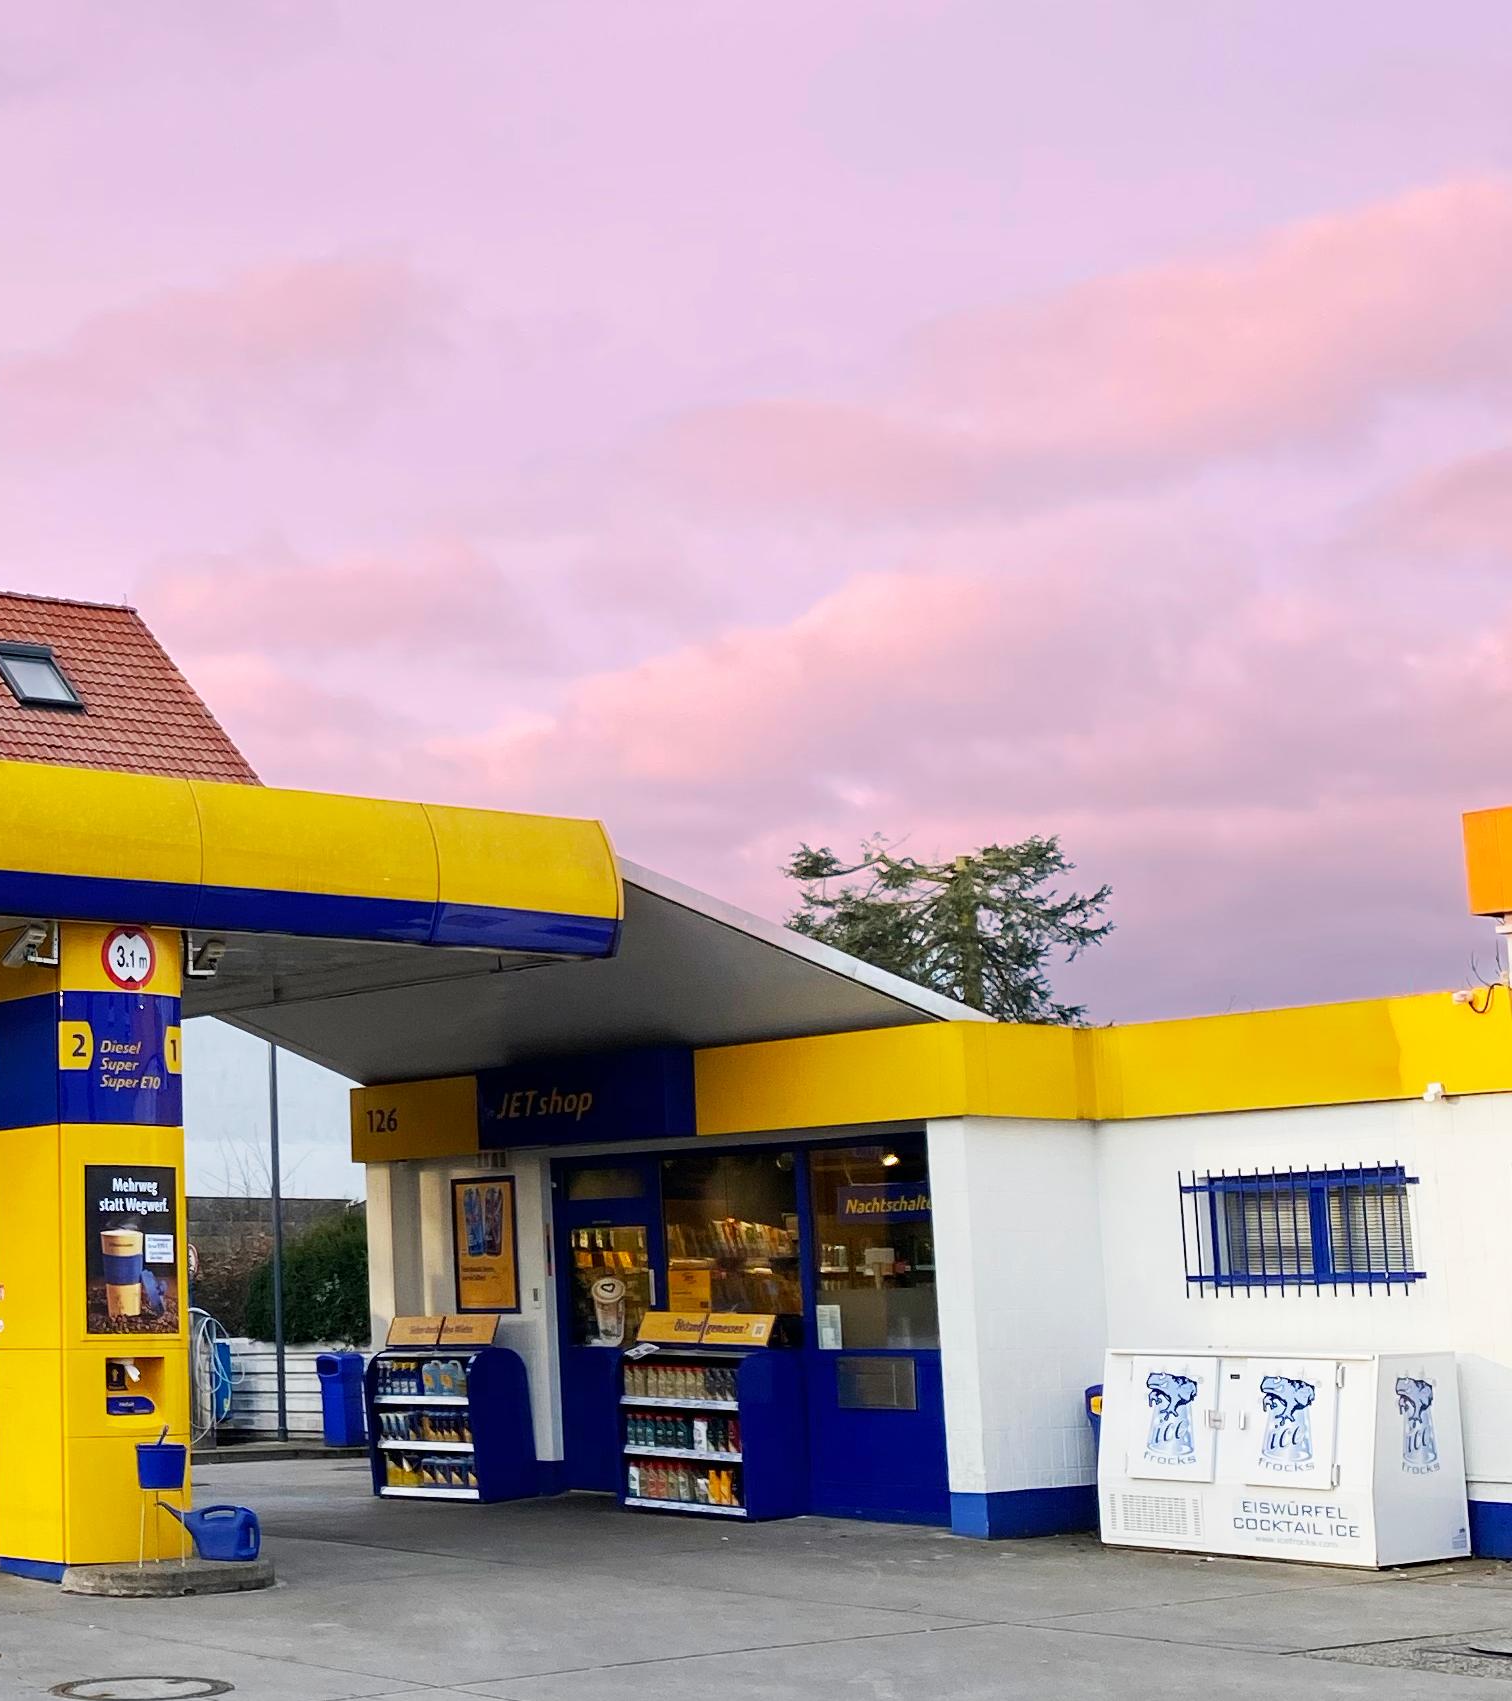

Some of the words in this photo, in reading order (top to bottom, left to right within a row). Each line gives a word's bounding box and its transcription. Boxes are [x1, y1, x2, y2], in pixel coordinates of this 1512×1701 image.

[116, 945, 136, 968] 3.1
[138, 956, 148, 969] m
[72, 1034, 87, 1057] 2
[100, 1040, 142, 1055] Diesel
[170, 1039, 177, 1062] 1
[100, 1057, 139, 1073] Super
[100, 1075, 138, 1092] Super
[140, 1076, 161, 1090] E10
[366, 1108, 398, 1133] 126
[112, 1177, 158, 1196] Mehrweg
[99, 1198, 125, 1211] statt
[1258, 1457, 1315, 1473] frocks
[1233, 1517, 1323, 1536] COCKTAIL
[1330, 1524, 1360, 1538] ICE
